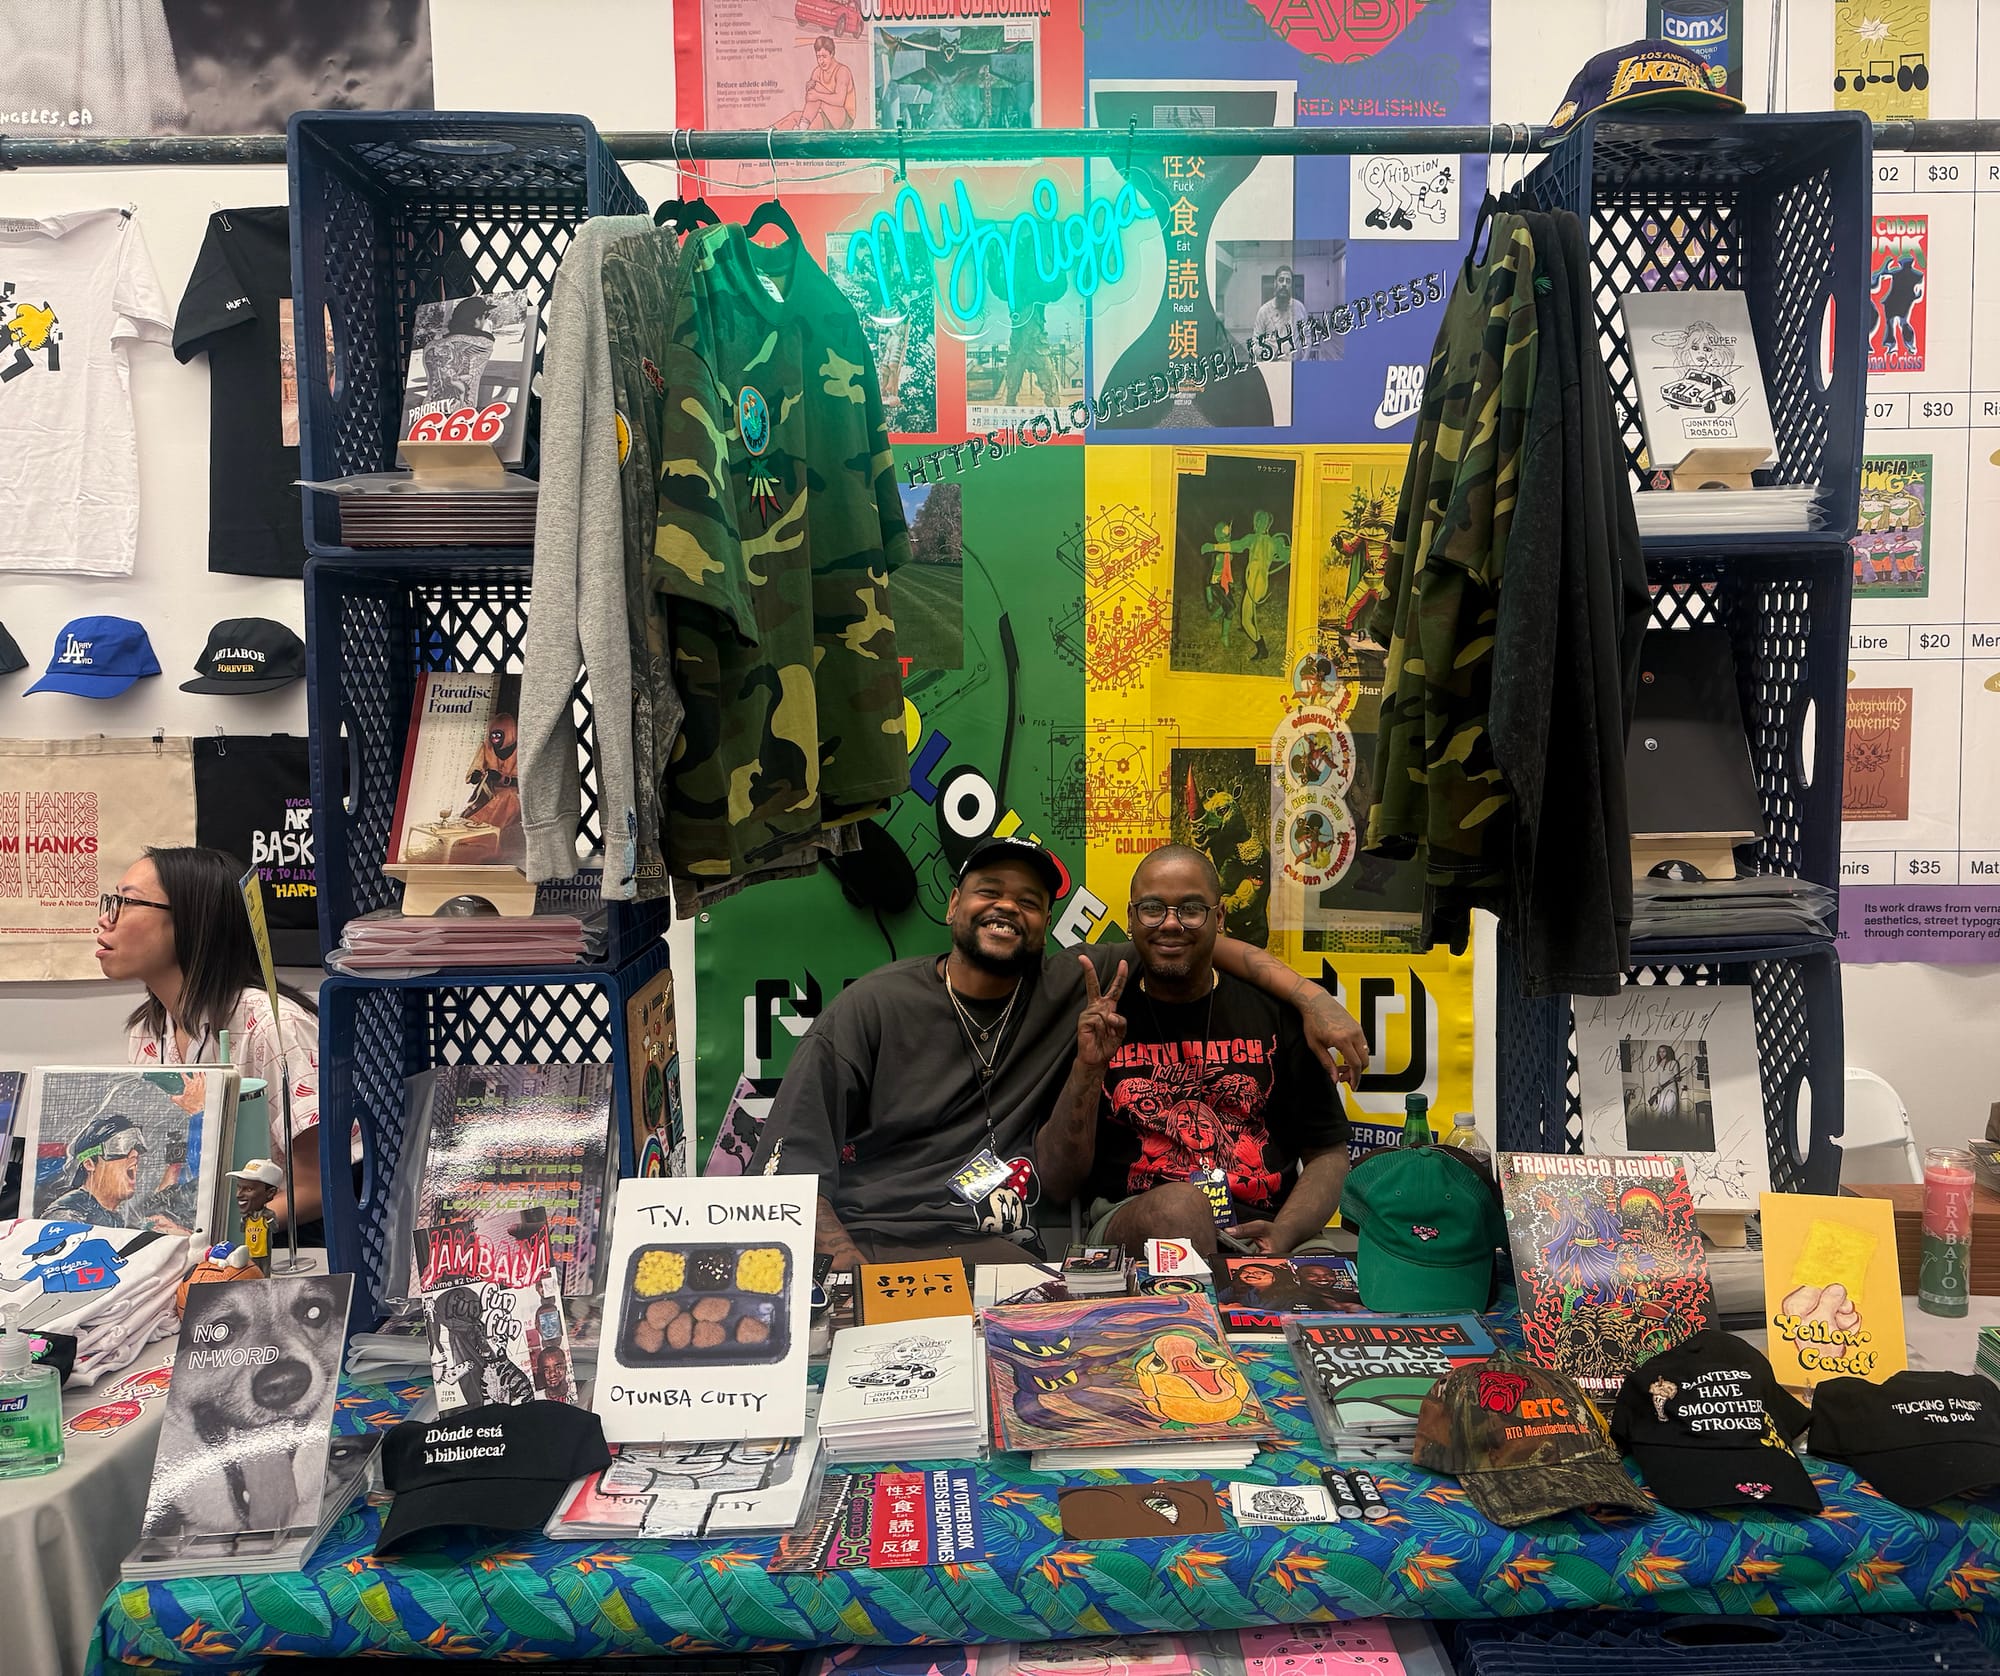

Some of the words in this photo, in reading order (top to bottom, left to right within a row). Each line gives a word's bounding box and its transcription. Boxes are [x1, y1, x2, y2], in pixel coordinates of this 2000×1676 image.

[1665, 16, 1723, 39] CDMX
[1639, 52, 1662, 61] LOS
[1339, 99, 1446, 118] PUBLISHING
[1878, 167, 1898, 181] 02
[1928, 166, 1959, 181] $30
[1173, 181, 1194, 192] Fuck
[1169, 196, 1199, 238] 食
[1875, 218, 1926, 234] Cuban
[1176, 241, 1191, 252] Eat
[1168, 259, 1199, 299] 読
[1173, 303, 1194, 313] Read
[1708, 335, 1738, 345] SUPER
[1888, 352, 1922, 370] Crisis
[1386, 366, 1424, 389] PRIO
[408, 398, 456, 426] PRIORITY
[1873, 404, 1894, 418] 07
[1922, 402, 1953, 418] $30
[408, 402, 511, 442] 666
[1849, 636, 1888, 648] Libre
[1919, 634, 1950, 648] $20
[217, 664, 255, 674] FOREVER
[431, 684, 491, 699] Paradise
[428, 700, 473, 714] Found
[26, 837, 98, 853] HANKS
[277, 868, 291, 879] TO
[1909, 860, 1941, 875] $35
[85, 900, 98, 908] Day
[1864, 904, 1878, 912] Its
[1880, 904, 1905, 913] work
[1907, 903, 1942, 913] draws
[1945, 904, 1971, 913] from
[1864, 916, 1921, 925] aesthetics,
[1924, 916, 1958, 925] street
[1864, 928, 1904, 939] through
[1906, 929, 1986, 941] contemporary
[1109, 1042, 1178, 1069] DEATH
[1181, 1038, 1264, 1064] MATCH
[1512, 1156, 1611, 1177] FRANCISCO
[1615, 1160, 1676, 1178] AGUDO
[499, 1181, 582, 1192] LETTERS
[443, 1199, 491, 1210] LOVE
[498, 1198, 580, 1209] LETTERS
[637, 1205, 690, 1227] T.V.
[708, 1203, 802, 1225] DINNER
[251, 1234, 257, 1242] 8
[1941, 1192, 1960, 1290] TRABAJO
[43, 1259, 93, 1276] Dodgers
[76, 1268, 104, 1285] 17
[454, 1277, 465, 1286] #2
[193, 1323, 229, 1344] NO
[1320, 1327, 1464, 1345] BUILDING
[1773, 1314, 1871, 1347] Yellow
[188, 1345, 279, 1370] N-WORD
[1335, 1346, 1447, 1361] GLASS
[1798, 1348, 1878, 1375] Card!
[1342, 1361, 1452, 1376] HOUSES
[1681, 1370, 1752, 1391] PAINTERS
[610, 1385, 692, 1408] OTUNBA
[701, 1390, 768, 1412] CUTTY
[1697, 1383, 1743, 1399] HAVE
[1520, 1398, 1569, 1419] RTC
[1678, 1399, 1765, 1417] SMOOTHER
[1691, 1416, 1762, 1432] STROKES
[425, 1425, 473, 1444] ¿Dónde
[476, 1423, 503, 1438] está
[1505, 1426, 1523, 1440] RTC
[434, 1443, 506, 1463] biblioteca?
[886, 1485, 923, 1497] 性交
[932, 1470, 949, 1499] NEEDS
[953, 1478, 967, 1493] MY
[891, 1500, 916, 1514] 食
[954, 1494, 970, 1521] OTHER
[888, 1519, 915, 1534] 読
[935, 1499, 955, 1562] HEADPHONES
[957, 1520, 975, 1550] BOOK
[880, 1540, 921, 1554] 反復
